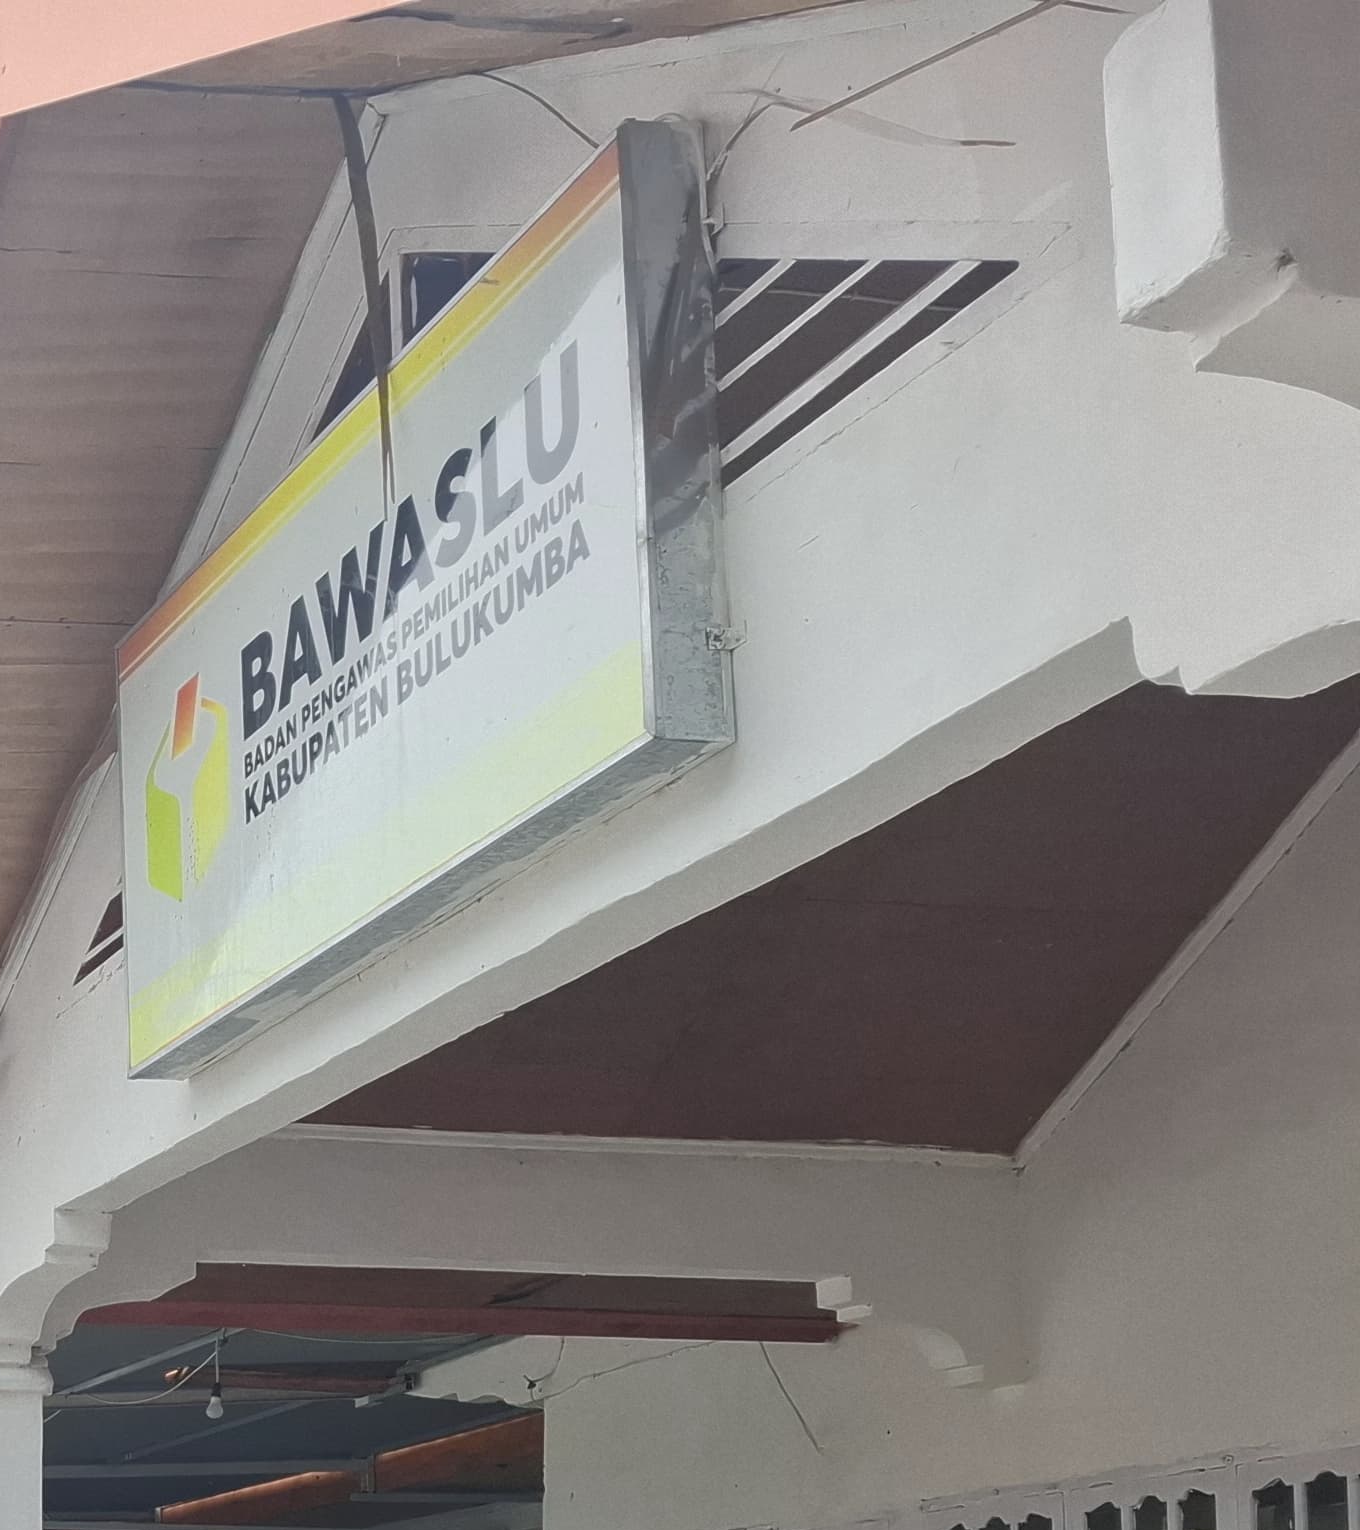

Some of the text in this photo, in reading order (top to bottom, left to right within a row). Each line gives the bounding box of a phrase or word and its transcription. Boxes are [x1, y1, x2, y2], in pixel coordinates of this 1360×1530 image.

[241, 339, 581, 742] BAWASLU
[245, 471, 585, 779] BADAN PENGAWAS PEMILIHAN UMUM
[245, 518, 591, 825] KABUPATEN BULUKUMBA
